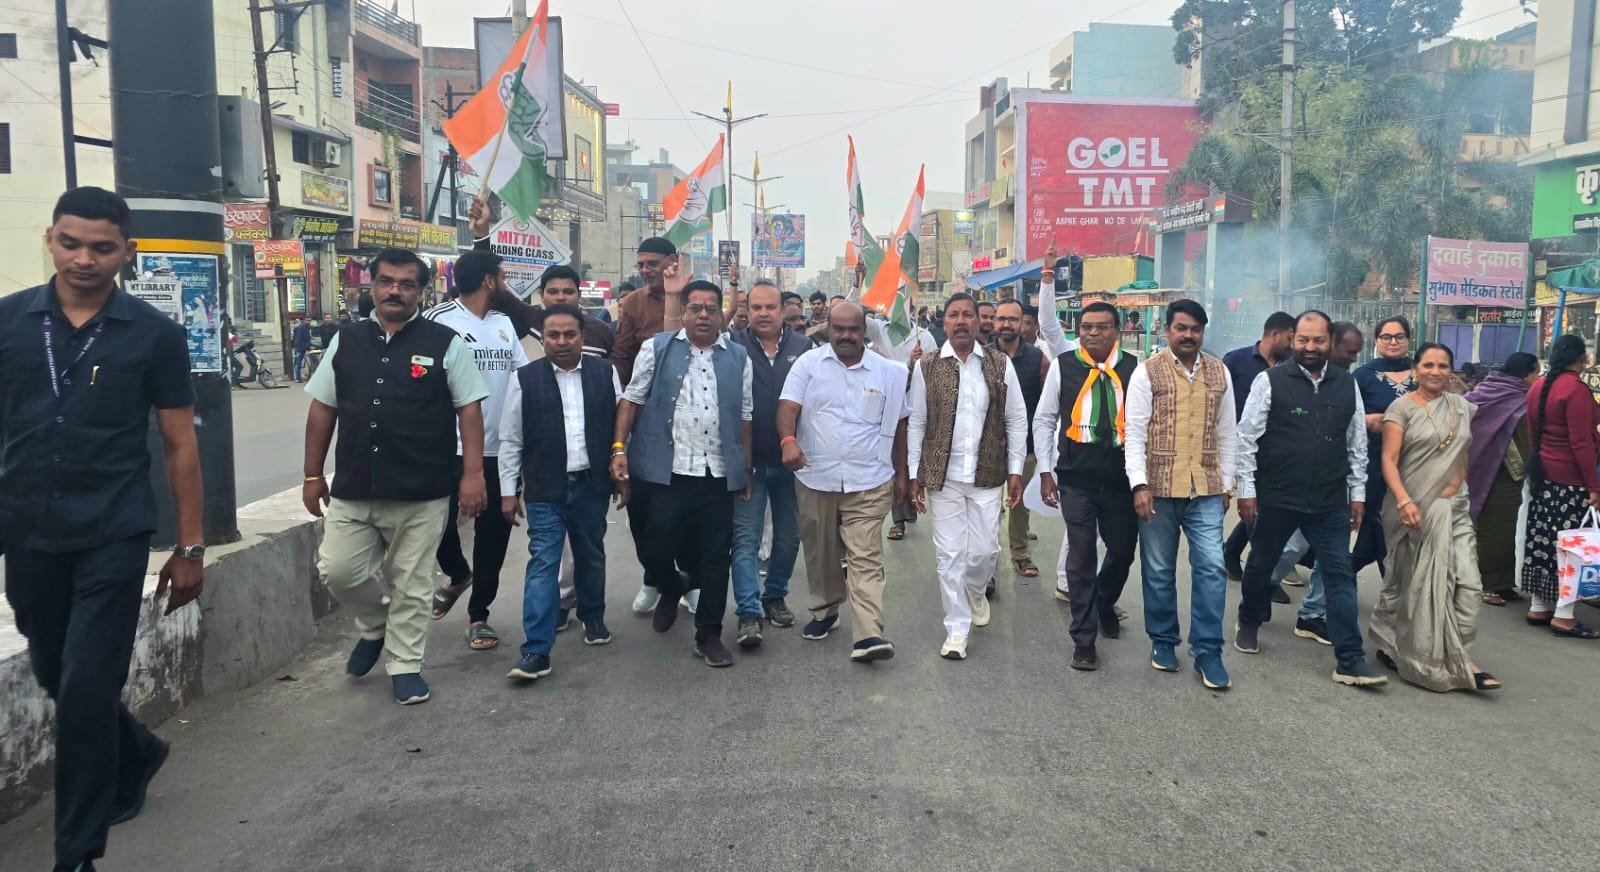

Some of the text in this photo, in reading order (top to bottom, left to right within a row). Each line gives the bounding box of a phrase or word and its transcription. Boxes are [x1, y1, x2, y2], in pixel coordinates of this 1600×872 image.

[1067, 137, 1168, 169] GOEL
[1078, 177, 1156, 206] TMT
[1056, 217, 1077, 226] AAPKE
[1080, 216, 1098, 225] GHAR
[1104, 216, 1114, 225] KO
[1117, 216, 1126, 225] DE
[497, 230, 542, 248] MITTAL
[490, 244, 554, 260] RADING CLASS
[1432, 241, 1525, 276] दवाई दुकान
[140, 283, 176, 292] LIBRARY
[1428, 280, 1457, 301] सुभाष
[469, 346, 513, 360] mirates
[1581, 566, 1600, 583] D
